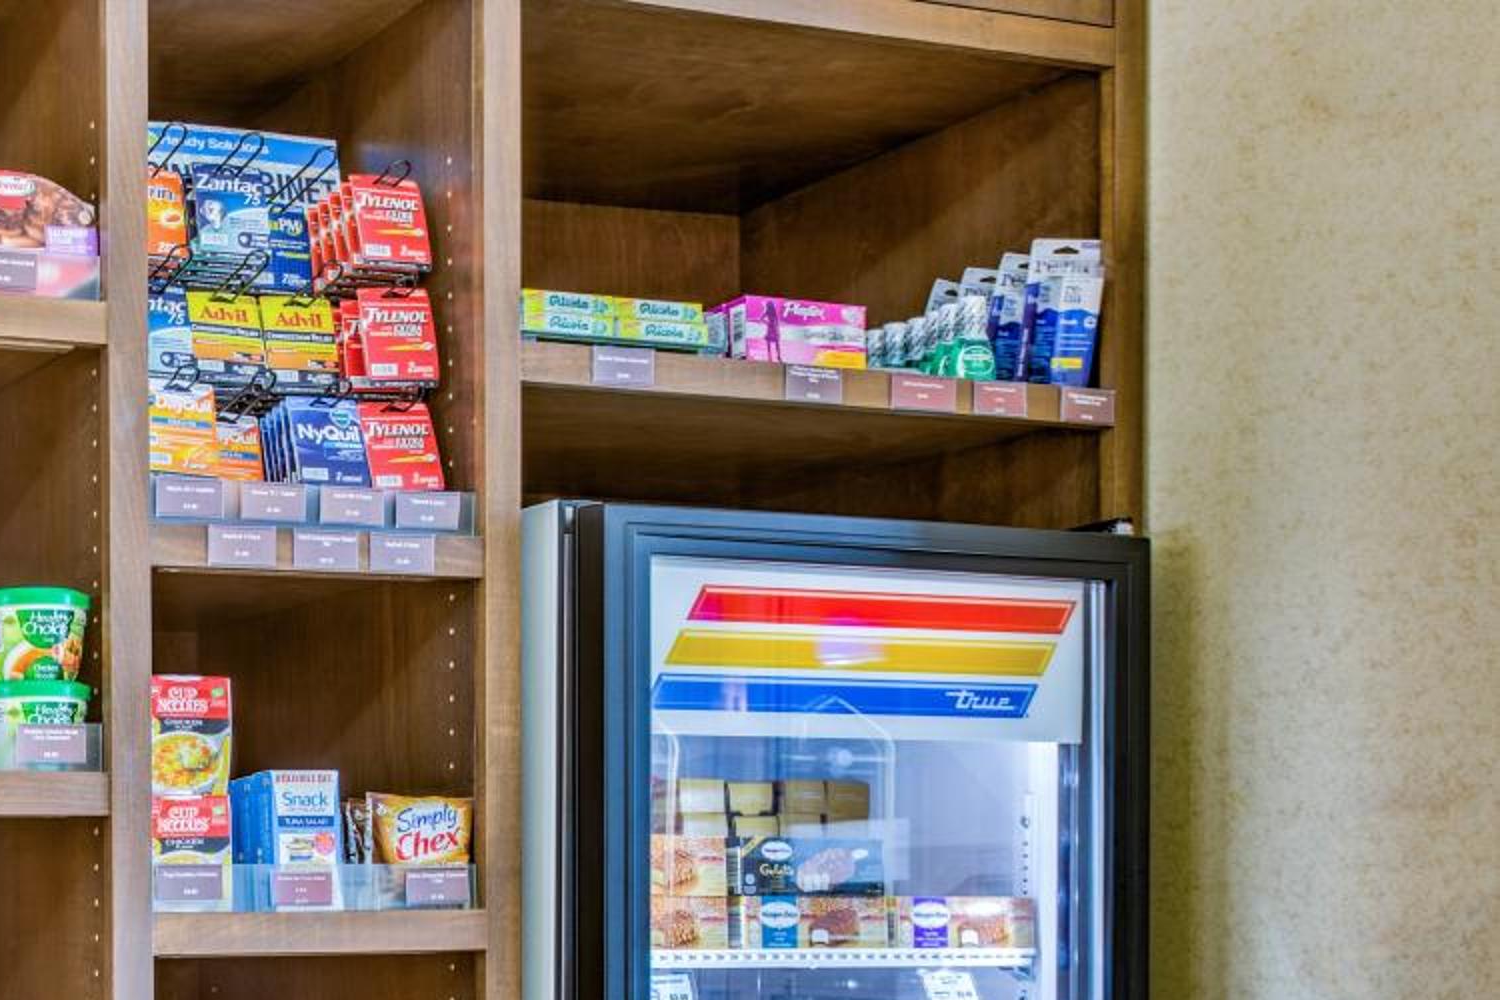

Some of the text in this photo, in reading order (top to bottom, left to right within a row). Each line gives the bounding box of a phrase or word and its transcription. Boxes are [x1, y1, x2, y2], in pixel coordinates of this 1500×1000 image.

[196, 173, 262, 194] Zantac
[243, 194, 262, 206] 75
[148, 297, 187, 313] ntac
[200, 305, 249, 323] Advil
[639, 302, 680, 318] Ricola
[276, 311, 324, 329] Advil
[644, 323, 686, 339] Ricola
[297, 423, 361, 445] NyQuil
[282, 791, 328, 807] Snack
[397, 803, 458, 833] Simply
[395, 827, 461, 861] Chex
